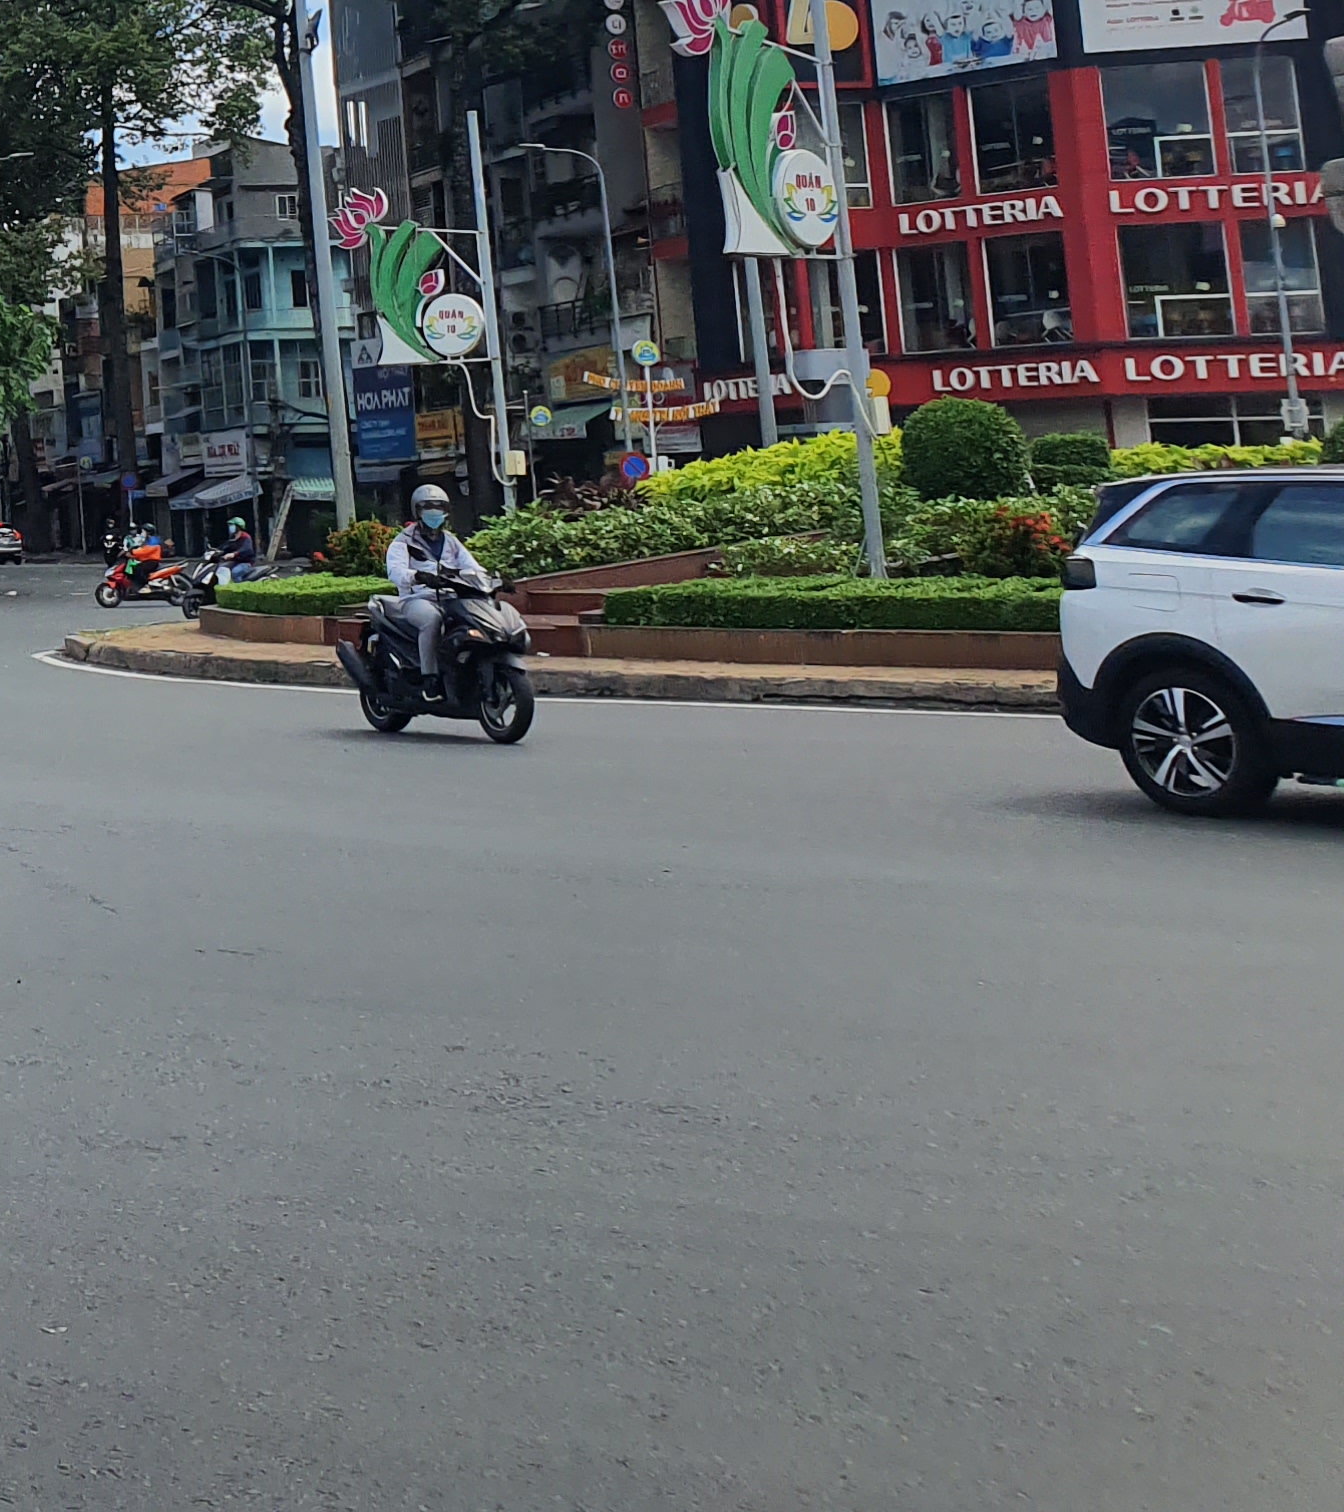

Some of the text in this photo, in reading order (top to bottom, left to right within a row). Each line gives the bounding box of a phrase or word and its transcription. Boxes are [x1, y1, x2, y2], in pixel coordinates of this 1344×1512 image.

[805, 198, 816, 211] 10
[898, 195, 1064, 235] LOTTERIA
[932, 359, 1100, 392] LOTTERIA
[1124, 351, 1344, 382] LOTTERIA
[703, 373, 792, 401] LOTTEIA
